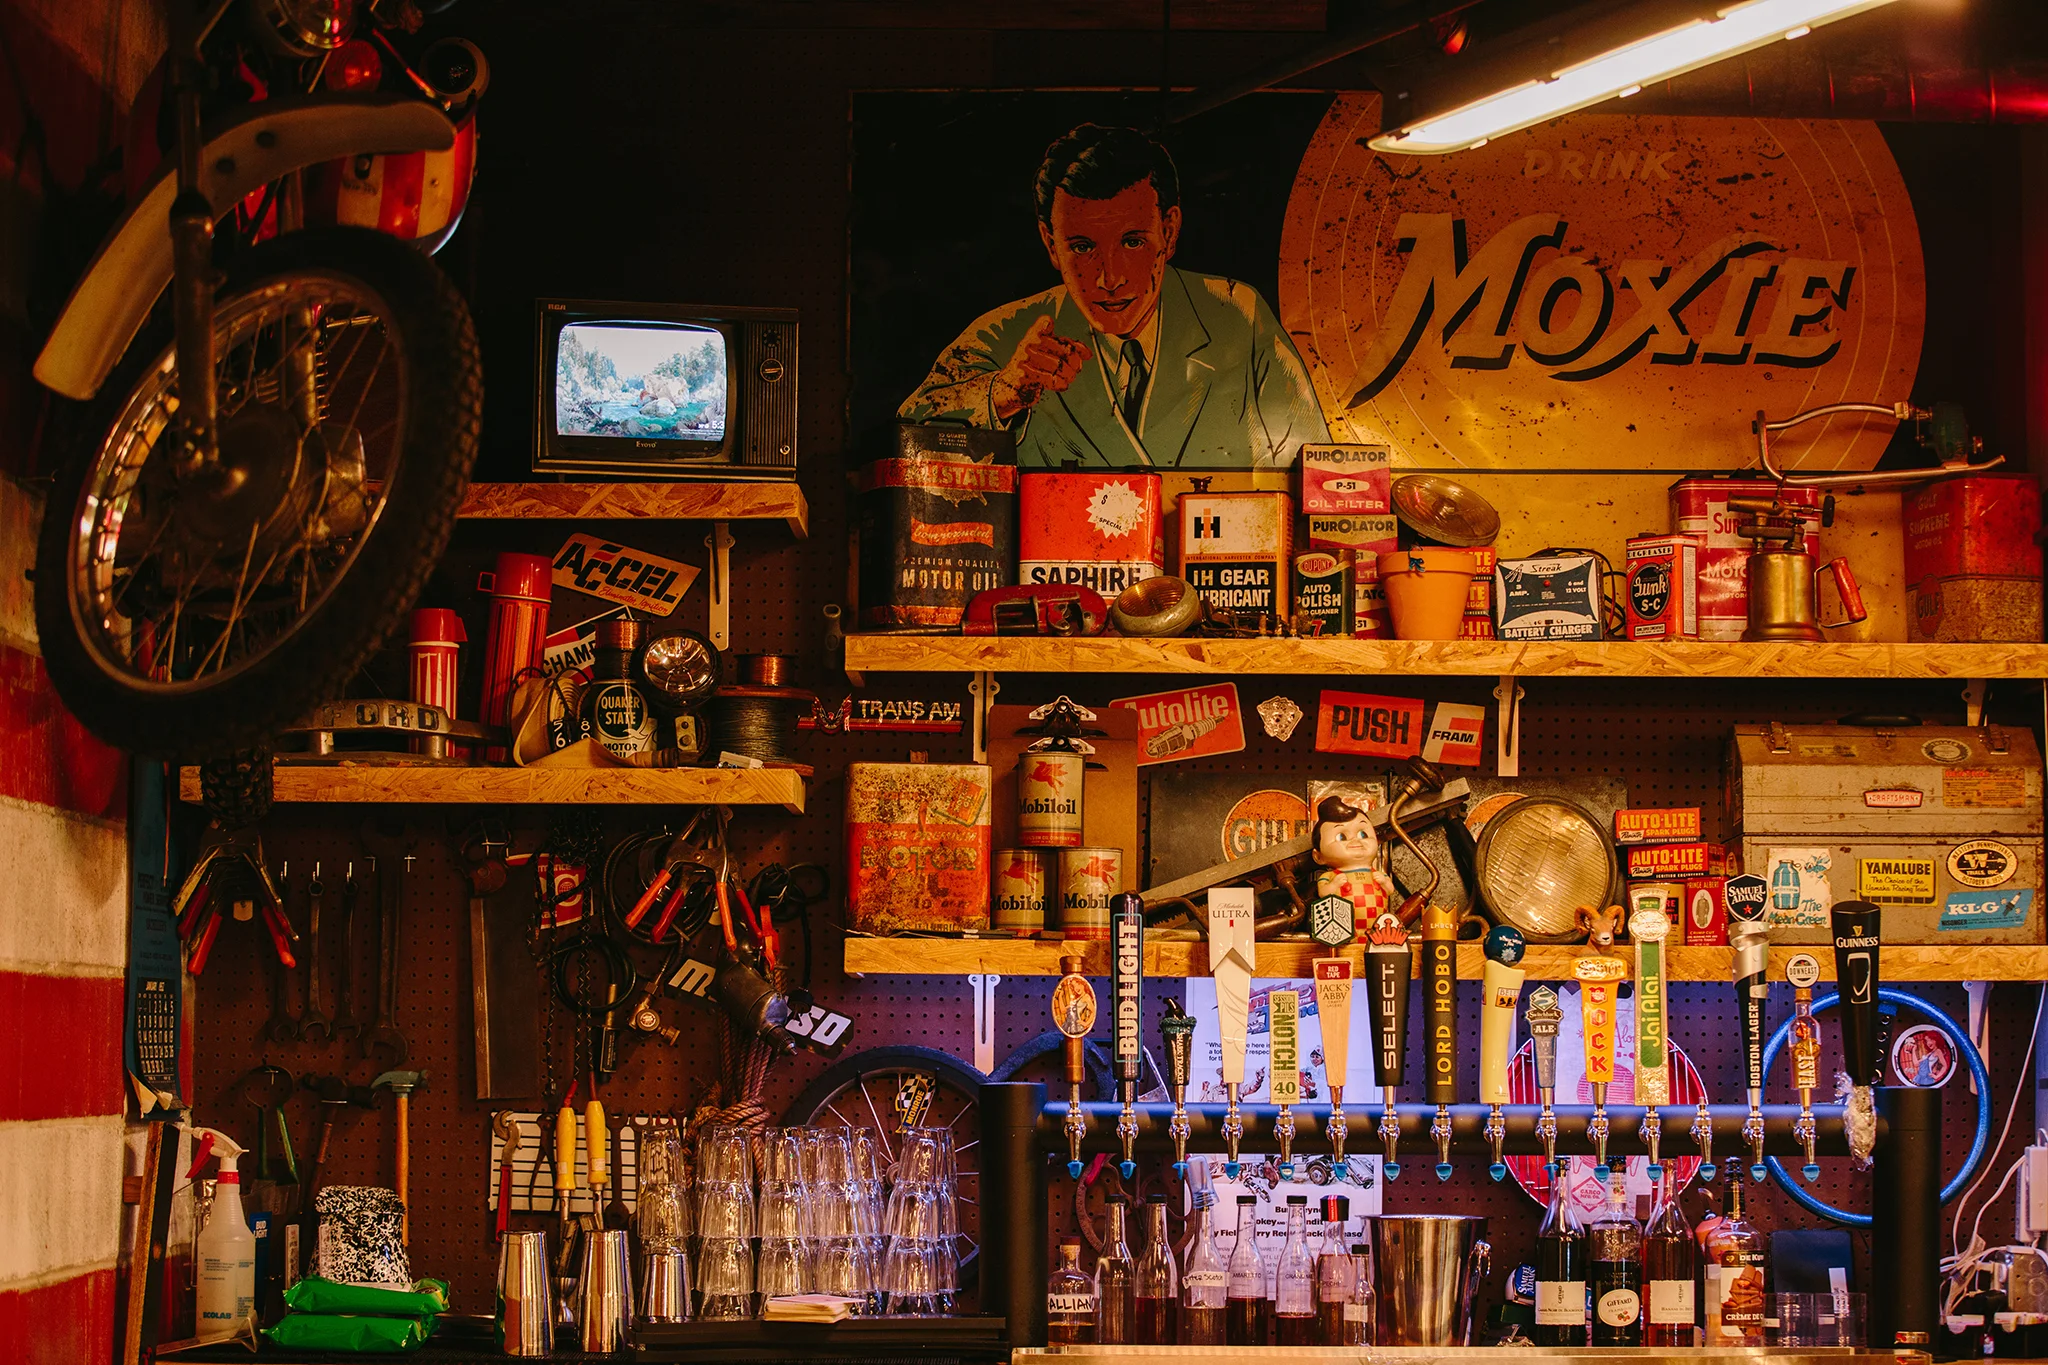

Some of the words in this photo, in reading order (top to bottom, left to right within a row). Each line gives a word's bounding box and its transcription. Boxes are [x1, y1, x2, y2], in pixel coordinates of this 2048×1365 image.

[1523, 149, 1678, 183] DRINK
[1306, 449, 1387, 463] PUROLATOR
[1336, 482, 1356, 490] P-51
[1308, 500, 1333, 508] OIL
[1336, 500, 1384, 509] FILTER
[1099, 517, 1123, 531] SPECIAL
[1313, 519, 1395, 534] PUROLATOR
[553, 542, 680, 604] ACCEL
[902, 569, 965, 591] MOTOR
[1193, 570, 1214, 586] IH
[1220, 569, 1270, 586] GEAR
[1303, 584, 1331, 594] AUTO
[1641, 598, 1661, 611] S-C
[1312, 619, 1323, 637] 7
[1505, 627, 1545, 638] BATTERY
[1549, 625, 1593, 636] CHARGER
[601, 696, 640, 709] QUAKER
[858, 700, 924, 718] TRANS
[930, 702, 961, 718] AM
[321, 703, 440, 731] FORD
[605, 711, 636, 725] STATE
[1332, 704, 1411, 745] PUSH
[556, 732, 566, 748] 6
[603, 743, 638, 751] MOTOR
[1872, 794, 1915, 802] CRAFTSMAN
[1019, 798, 1077, 815] Mobiloil
[1952, 844, 1975, 860] WESTERN
[1866, 862, 1931, 875] YAMALUBE
[1871, 876, 1883, 884] The
[1884, 876, 1905, 884] Choice
[1728, 885, 1766, 897] SAMUEL
[1866, 884, 1891, 893] Yamaha
[1892, 884, 1913, 893] Racing
[1912, 884, 1930, 893] Team
[1731, 893, 1764, 905] ADAMS
[1801, 898, 1822, 912] The
[1212, 910, 1250, 918] ULTRA
[1836, 935, 1879, 948] GUINNESS
[1118, 921, 1139, 997] LIGHT
[1435, 944, 1451, 1012] HOBO
[1789, 967, 1818, 975] DOWNEAST
[1319, 984, 1351, 992] JACK'S
[1323, 992, 1348, 1000] ABBY
[1280, 1002, 1296, 1013] PILS
[1118, 1001, 1139, 1055] BUD
[1535, 1025, 1555, 1033] ALE
[1588, 986, 1609, 1074] BOCK
[1748, 1006, 1760, 1040] LAGER
[1642, 1017, 1660, 1047] Jai
[1273, 1015, 1296, 1070] NOTCH
[1437, 1025, 1452, 1086] LORD
[1749, 1045, 1761, 1087] BOSTON
[905, 1091, 924, 1124] MONROE
[256, 1221, 267, 1229] BUD
[1518, 1265, 1533, 1294] SAMUEL
[1526, 1269, 1535, 1294] ADAMS
[1606, 1298, 1633, 1307] GIFFARD
[1726, 1312, 1752, 1321] CRÈME
